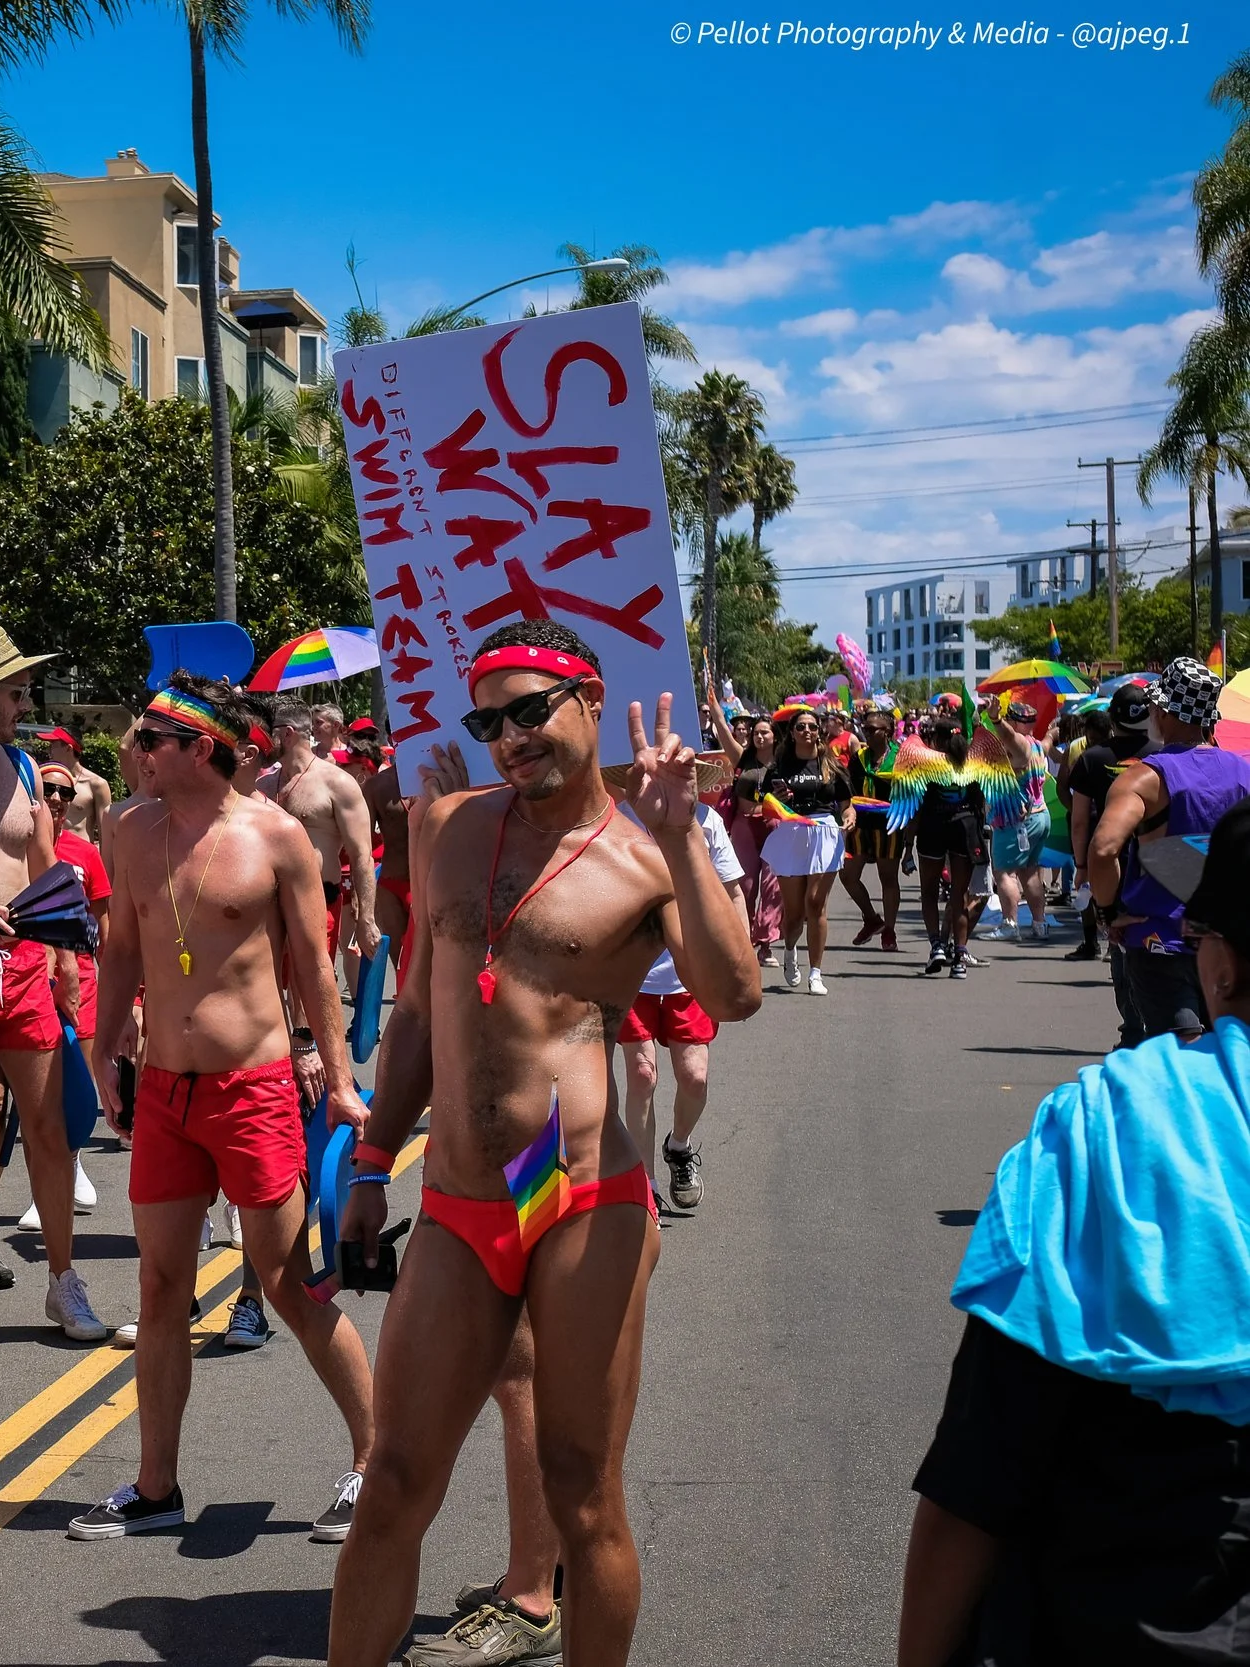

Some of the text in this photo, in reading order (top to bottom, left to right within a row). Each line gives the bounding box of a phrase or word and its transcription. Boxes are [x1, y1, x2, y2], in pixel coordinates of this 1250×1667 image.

[342, 379, 443, 744] SWIM TEAM
[380, 362, 472, 681] DIFFERENT STROKES
[483, 325, 665, 651] SLAY
